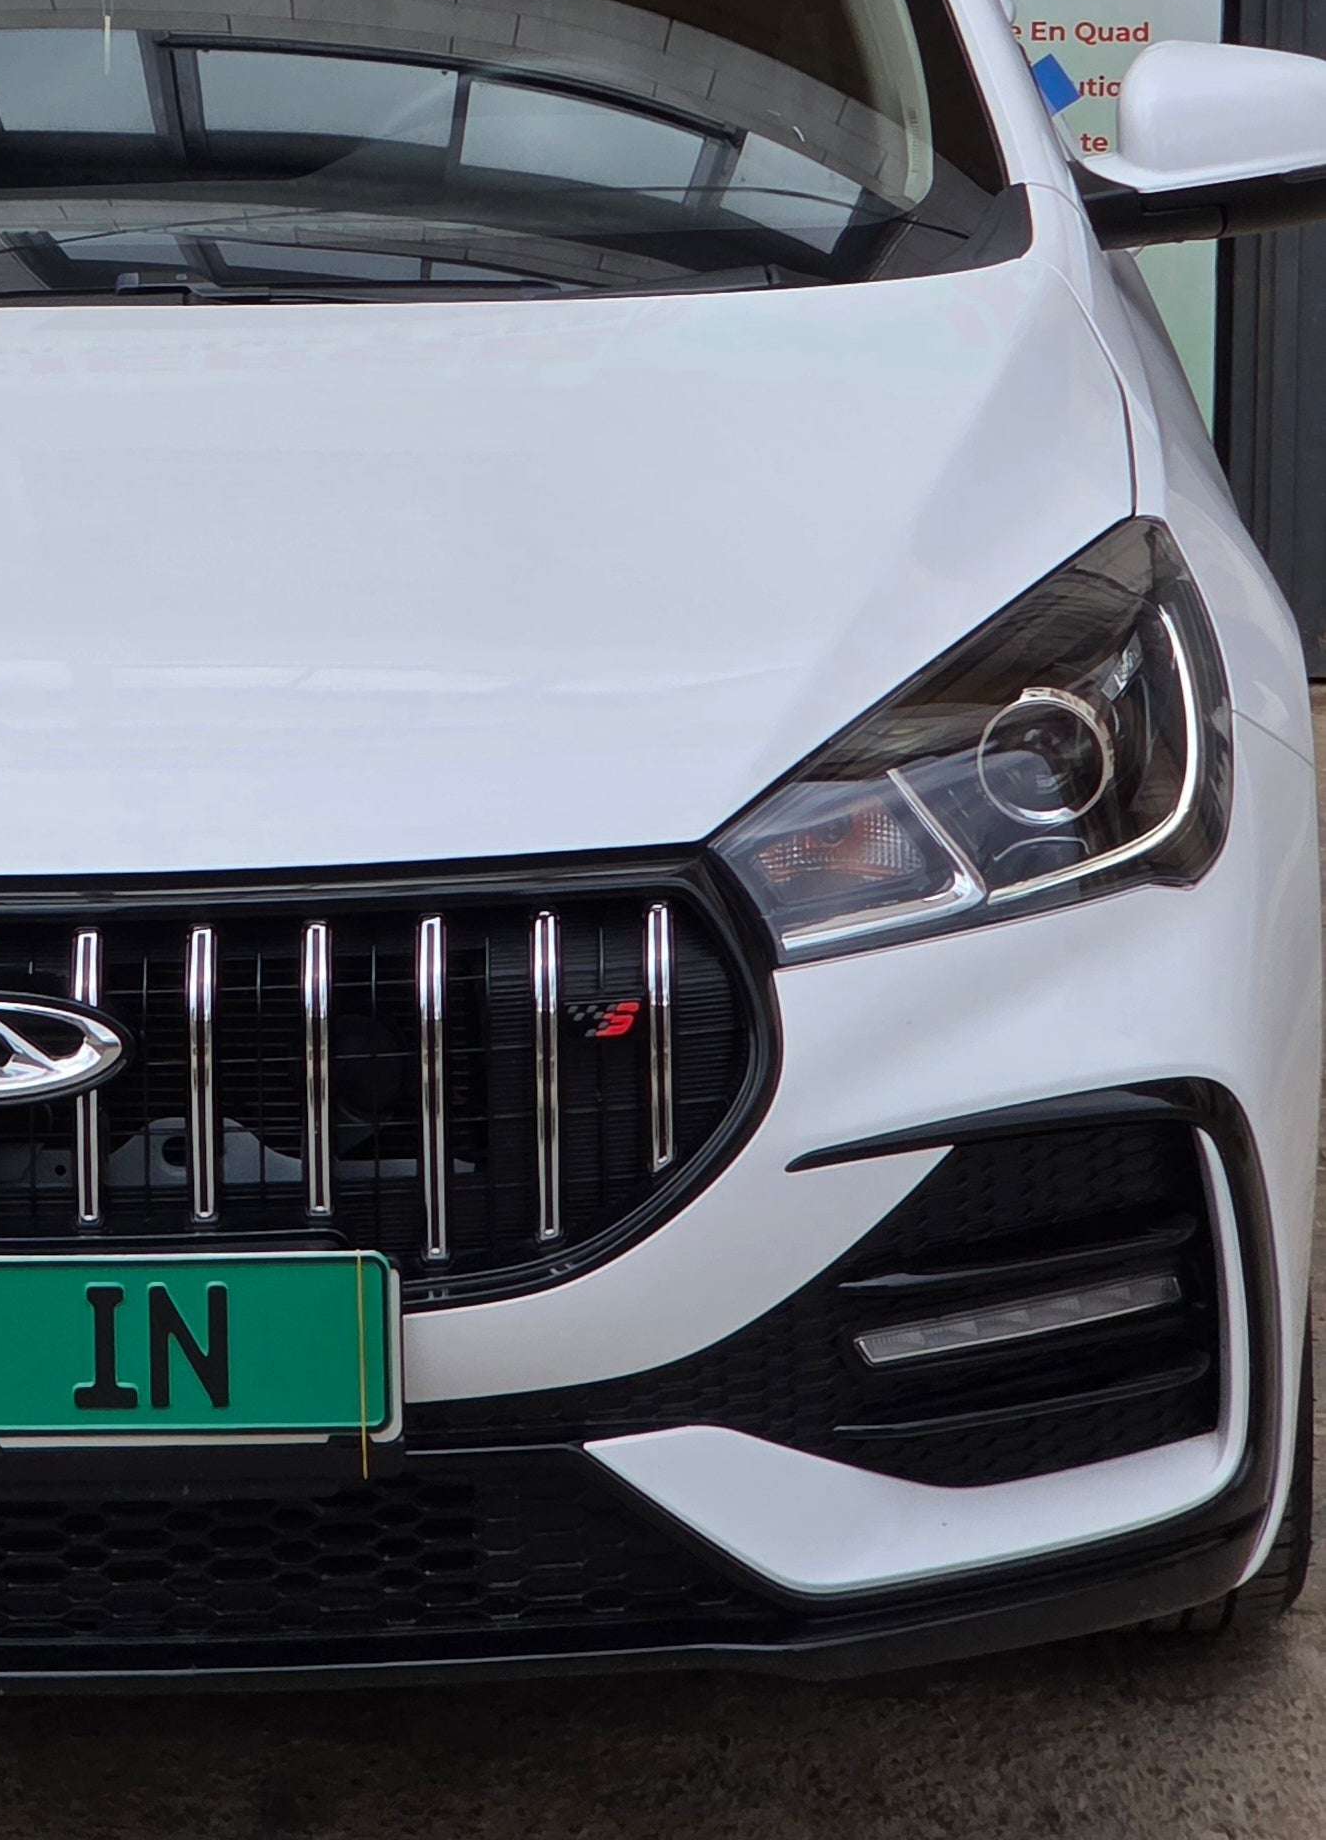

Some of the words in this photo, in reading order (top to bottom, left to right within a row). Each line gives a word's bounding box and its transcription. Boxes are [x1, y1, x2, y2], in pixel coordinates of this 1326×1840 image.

[1031, 21, 1065, 41] En
[1075, 21, 1150, 45] Quad
[74, 1281, 231, 1410] IN
